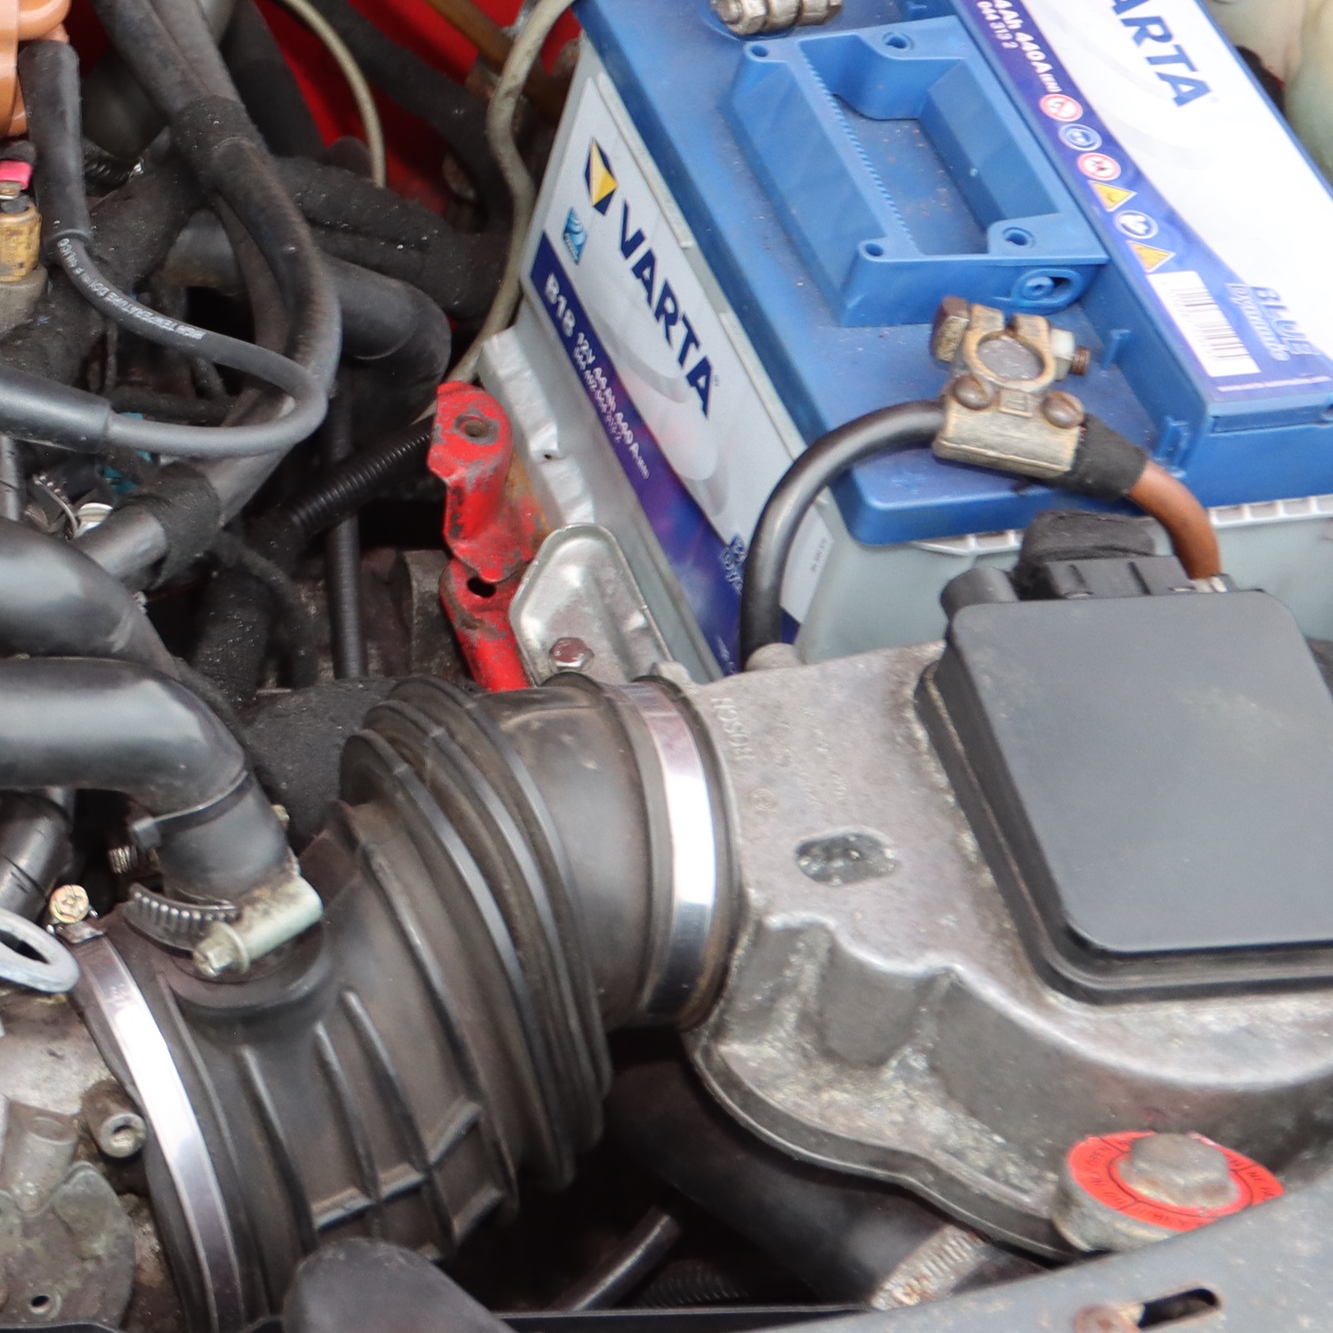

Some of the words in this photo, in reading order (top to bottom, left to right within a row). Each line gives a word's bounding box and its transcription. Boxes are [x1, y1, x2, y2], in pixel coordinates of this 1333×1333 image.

[104, 292, 178, 331] TEMPERATURE
[544, 272, 575, 338] B18
[620, 199, 713, 419] VARTA
